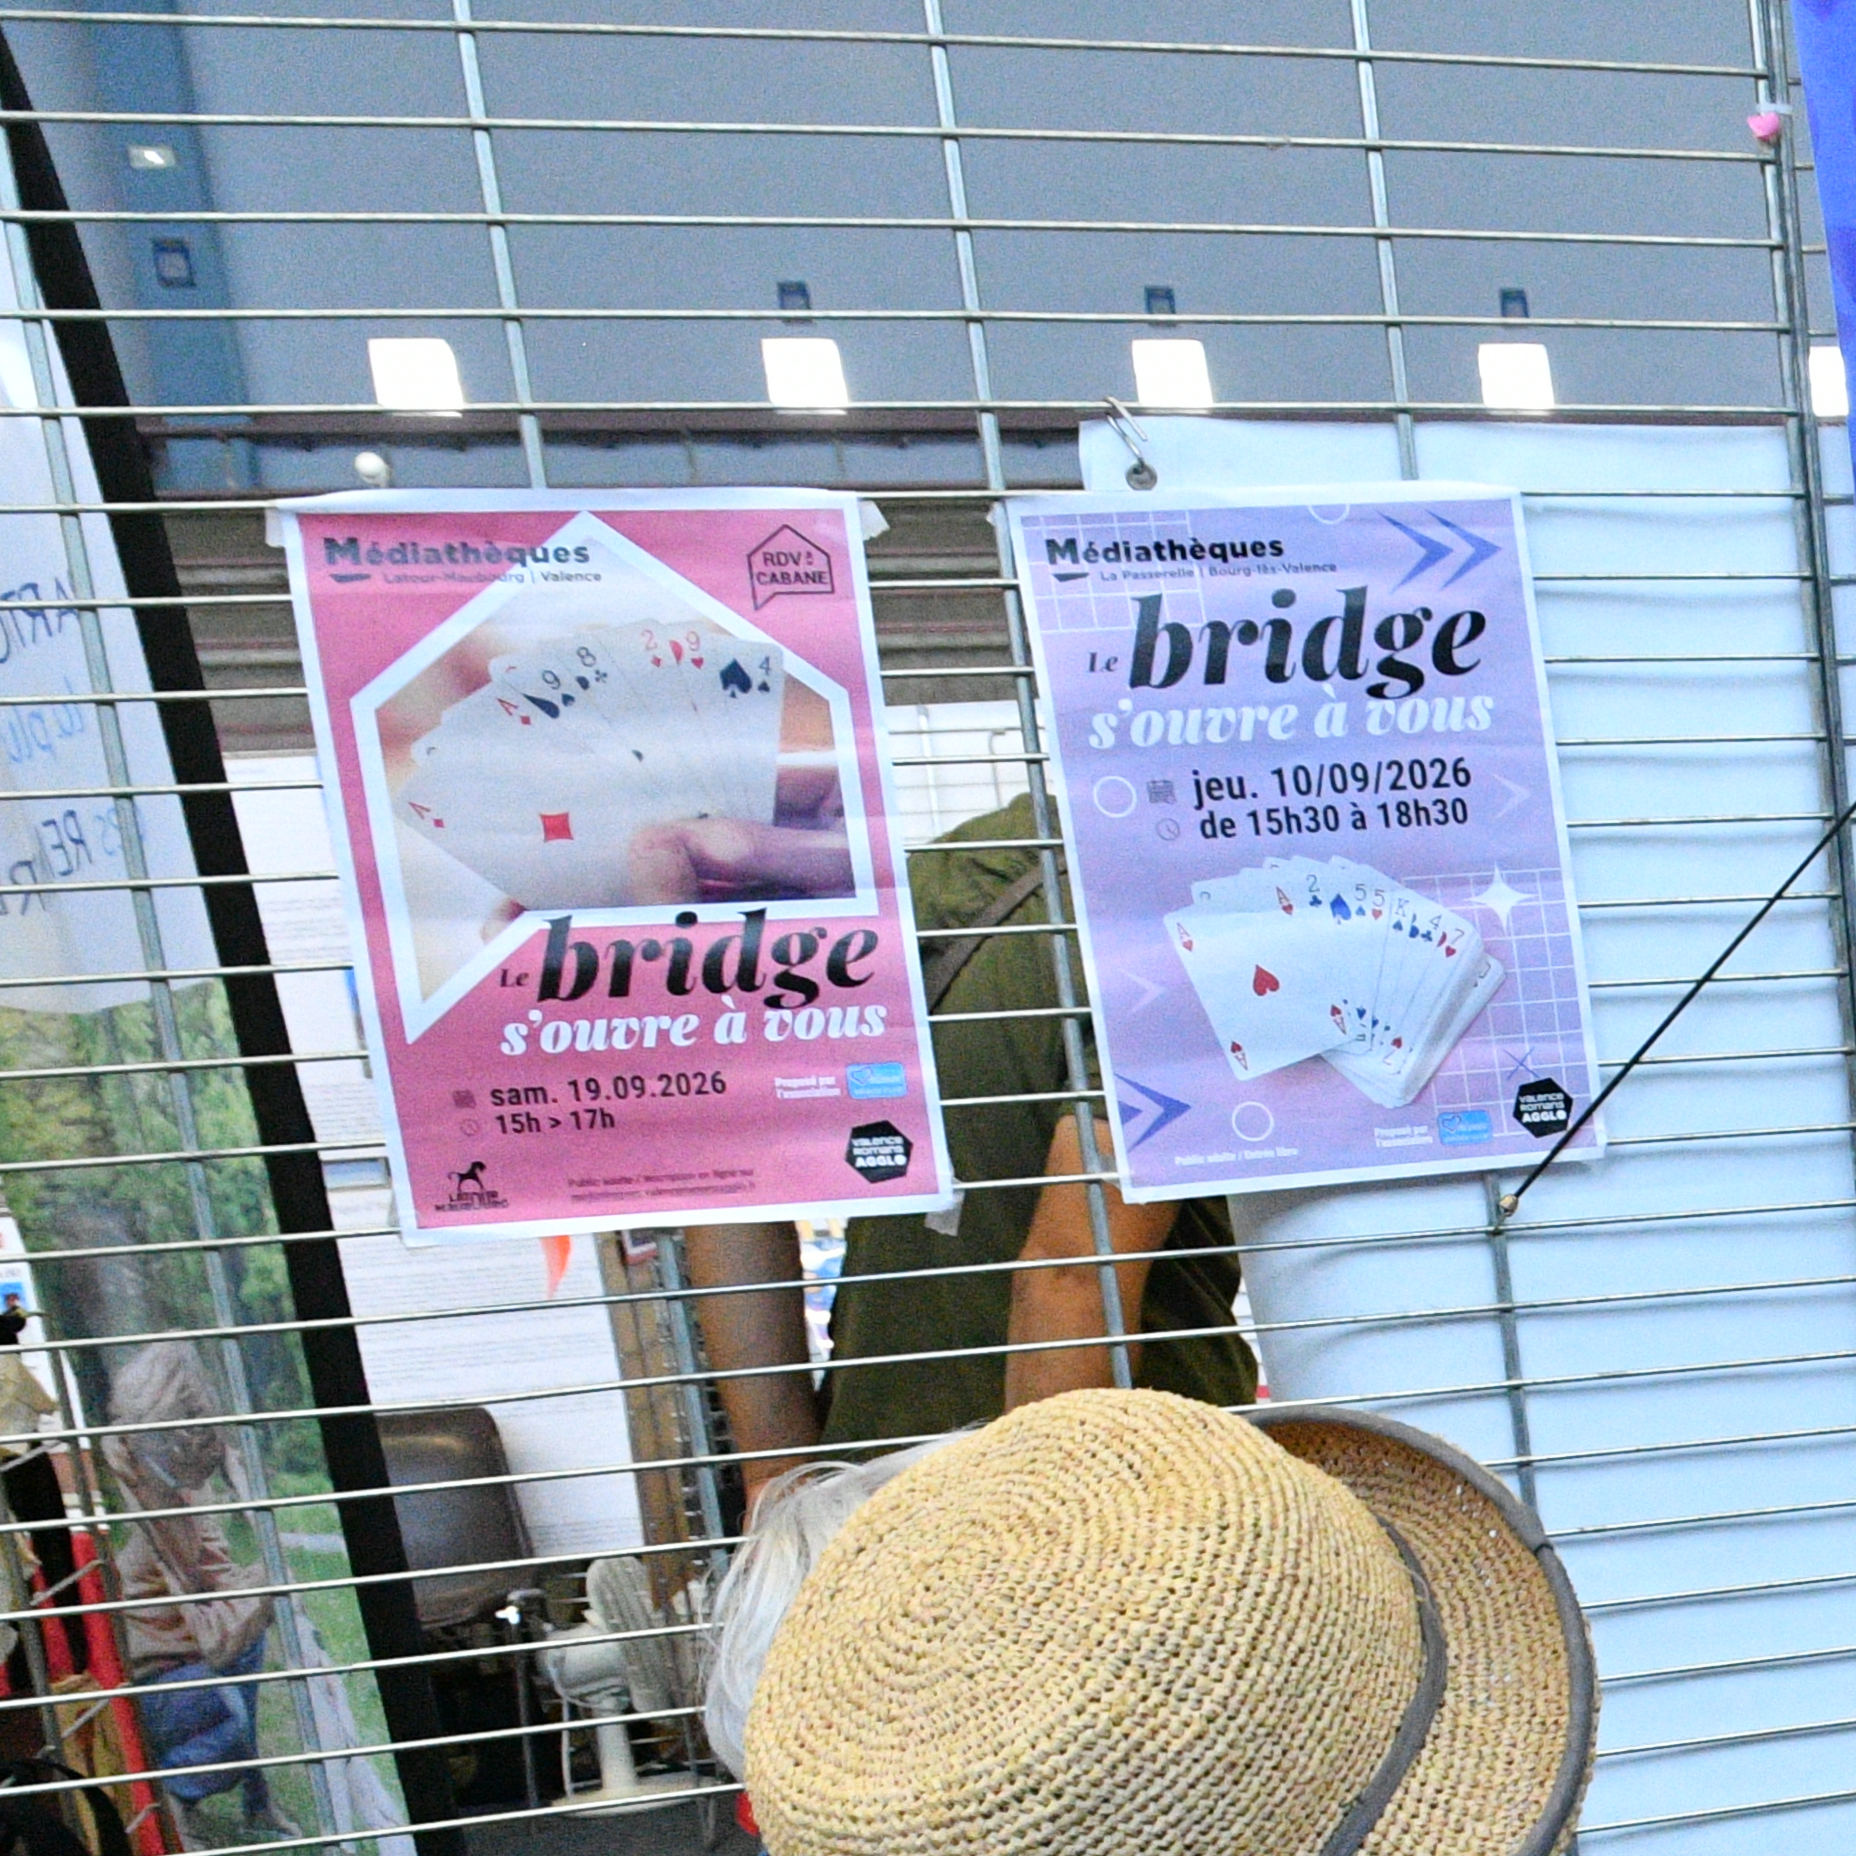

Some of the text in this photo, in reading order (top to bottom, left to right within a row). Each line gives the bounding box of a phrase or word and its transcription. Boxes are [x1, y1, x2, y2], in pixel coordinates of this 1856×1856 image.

[323, 537, 590, 567] Médiathèques
[762, 551, 801, 567] RDV
[1045, 537, 1285, 565] Médiathèques
[541, 571, 602, 583] Valence
[756, 570, 828, 585] CABANE
[1099, 571, 1118, 582] La
[1088, 584, 1487, 699] Le bridge
[1314, 684, 1349, 738] à
[1366, 695, 1495, 737] vous
[1191, 756, 1472, 810] jeu. 10/09/2026
[1200, 796, 1469, 839] de 15h30 à 18h30
[500, 907, 880, 1009] Le bridge
[713, 995, 747, 1044] à
[765, 1004, 887, 1043] vous
[490, 1071, 728, 1108] sam. 19.09.2026
[496, 1110, 542, 1135] 15h
[571, 1108, 616, 1131] 17h
